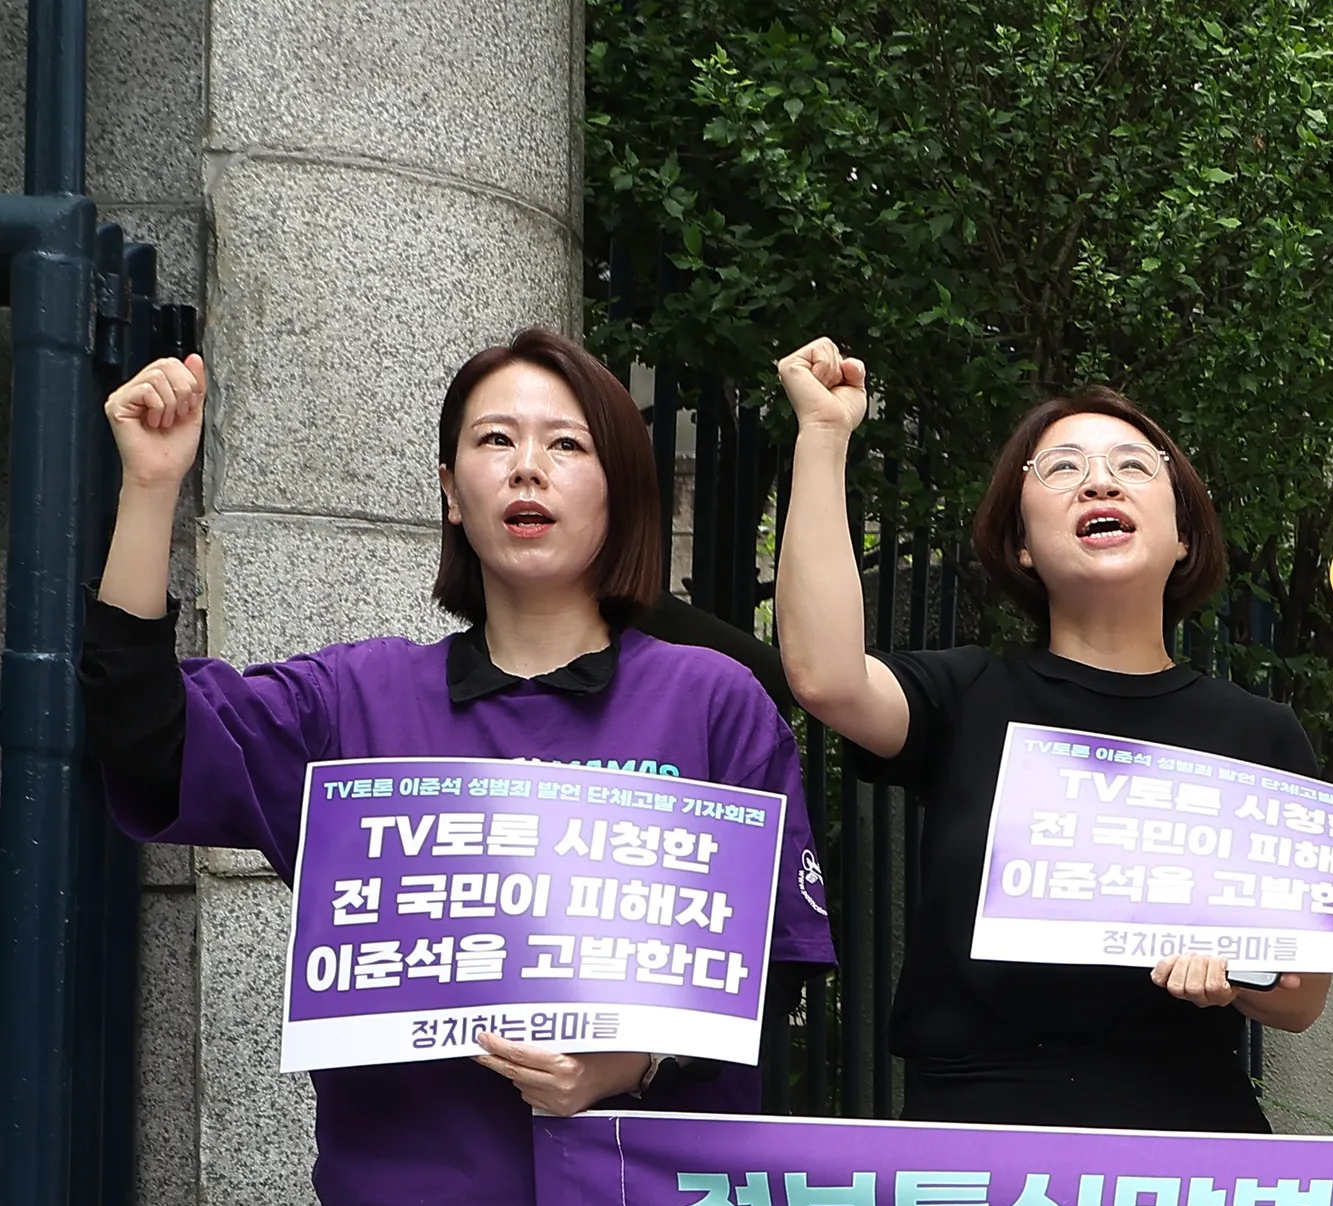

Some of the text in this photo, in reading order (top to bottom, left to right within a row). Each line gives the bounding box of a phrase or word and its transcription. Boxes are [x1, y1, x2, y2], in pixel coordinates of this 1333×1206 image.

[1024, 738, 1091, 759] TV토론
[1095, 745, 1152, 768] 이준석
[1157, 756, 1213, 778] 성범죄
[1218, 766, 1256, 786] 발언
[324, 777, 766, 828] TV토론 이준석 성범죄 발언 단체고발 기자회견
[1059, 768, 1222, 817] TV토론
[361, 812, 719, 874] TV토론 시청한
[1029, 810, 1078, 848] 전
[1091, 817, 1232, 860] 국민이
[332, 873, 732, 934] 전 국민이 피해자
[1002, 858, 1195, 905] 이준석을
[306, 934, 749, 995] 이준석을 고발한다
[411, 1011, 621, 1049] 정치하는엄마들
